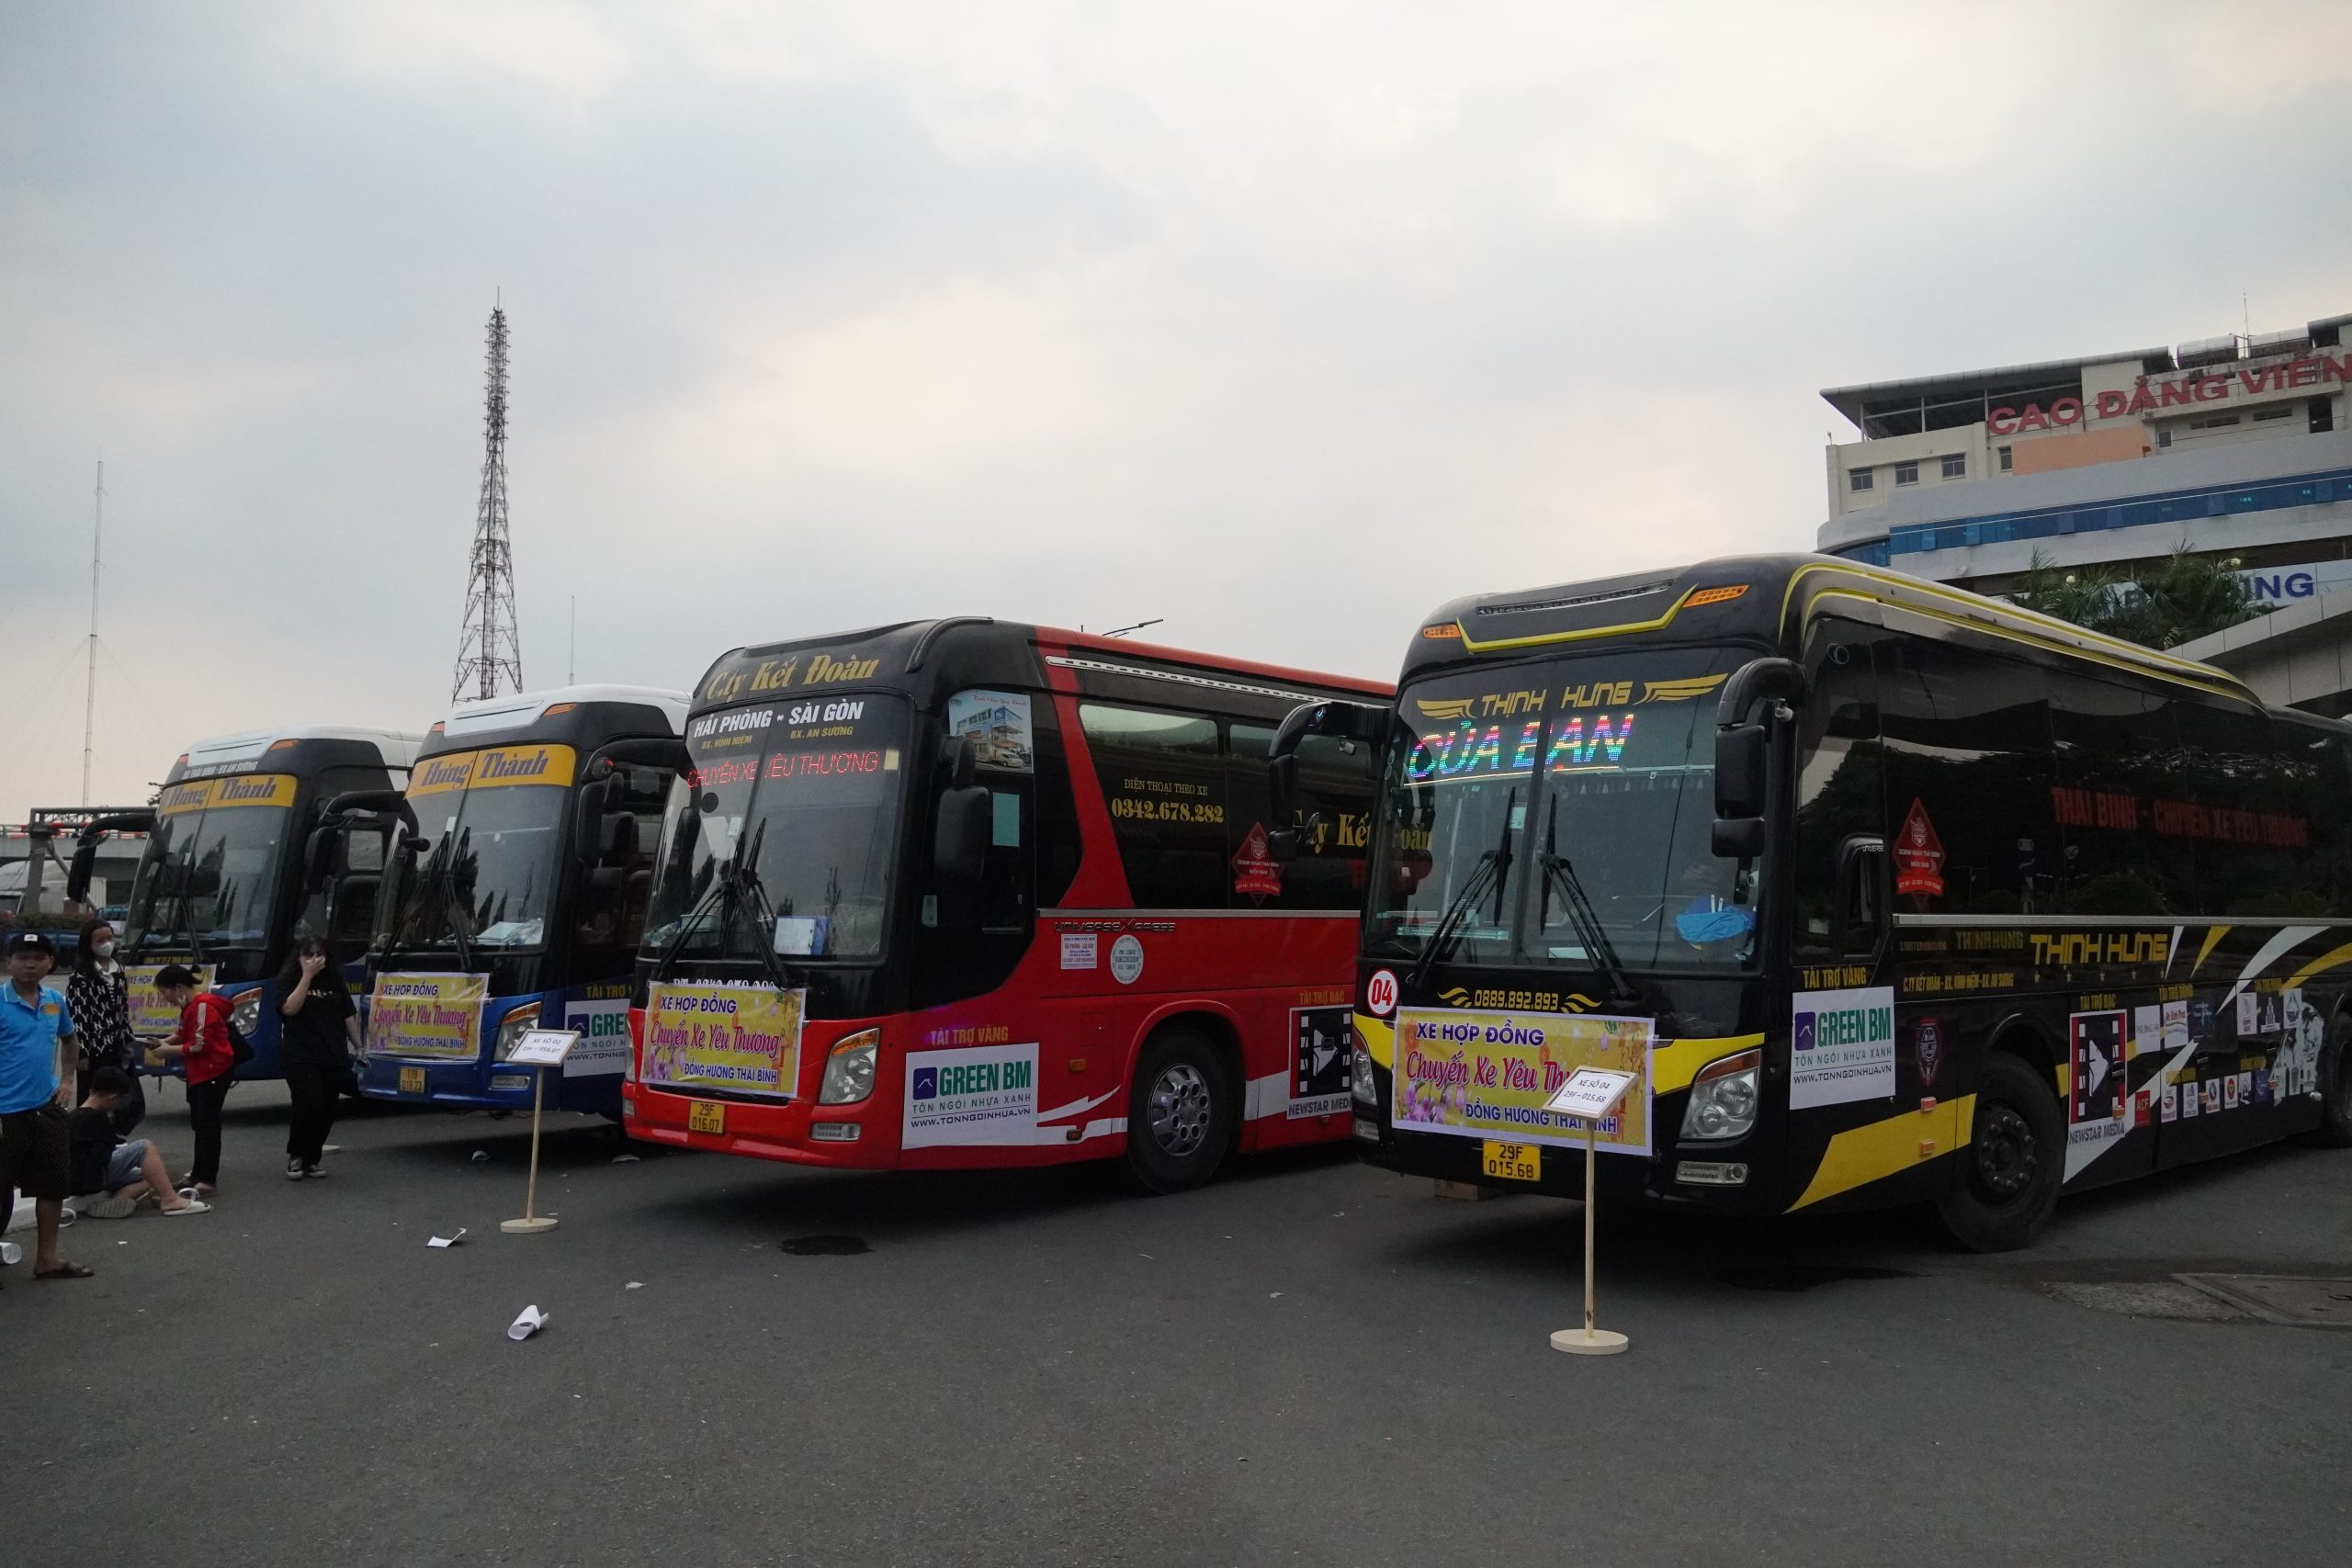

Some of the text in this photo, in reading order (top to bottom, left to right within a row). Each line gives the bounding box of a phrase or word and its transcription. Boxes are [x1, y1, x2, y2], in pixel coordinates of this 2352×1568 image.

[1989, 397, 2083, 435] CAO
[750, 656, 797, 691] Kết
[801, 653, 880, 686] Đoàn
[694, 713, 718, 738] HẢI
[718, 708, 773, 734] PHÒNG
[788, 702, 820, 725] SÀI
[823, 698, 864, 722] GÒN
[807, 728, 820, 738] AN
[1408, 720, 1499, 778] CỦA
[479, 749, 549, 779] Thành
[1124, 777, 1208, 796] ĐIỆN THOẠI THEO XE
[1111, 797, 1225, 823] 0342.678.282
[1803, 964, 1867, 990] TÀI TRỢ VÀNG
[586, 984, 603, 998] TÀI
[660, 991, 737, 1015] XE HỢP ĐỒNG
[1371, 978, 1392, 1006] 04
[1474, 989, 1559, 1010] 0889.892.893
[591, 1012, 628, 1037] GRE
[930, 1023, 1009, 1046] TÀI TRỢ VÀNG
[1417, 1019, 1544, 1046] XE HỢP ĐỒNG
[1817, 1007, 1891, 1048] GREEN BM
[650, 1019, 780, 1058] Chuyến Xe Yêu Thương
[567, 1051, 626, 1061] WWW.TONNG
[1794, 1054, 1814, 1066] TÔN
[1843, 1049, 1867, 1064] NHỰA
[1870, 1046, 1892, 1058] XANH
[684, 1059, 777, 1084] ĐỒNG HƯƠNG THÁI BÌNH
[939, 1060, 1032, 1096] GREEN BM
[1406, 1050, 1468, 1089] Chuyến
[1473, 1056, 1498, 1088] Xe
[1503, 1056, 1537, 1091] Yêu
[1793, 1065, 1892, 1085] WWW.TONNGOINHUA.VN
[1588, 1079, 1600, 1089] SỐ
[699, 1103, 714, 1117] 29F
[913, 1092, 1031, 1114] TÔN NGÓI NHỰA XANH
[1288, 1100, 1329, 1117] NEWSTAR
[1465, 1097, 1501, 1122] ĐỒNG
[1505, 1107, 1550, 1125] HƯƠNG
[692, 1117, 719, 1131] 016.07
[910, 1108, 1031, 1128] WWW.TONNGOINHUA.VN
[2069, 1121, 2125, 1145] NEWSTAR MEDIA
[1498, 1144, 1522, 1160] 29F
[1488, 1160, 1533, 1179] 015.68
